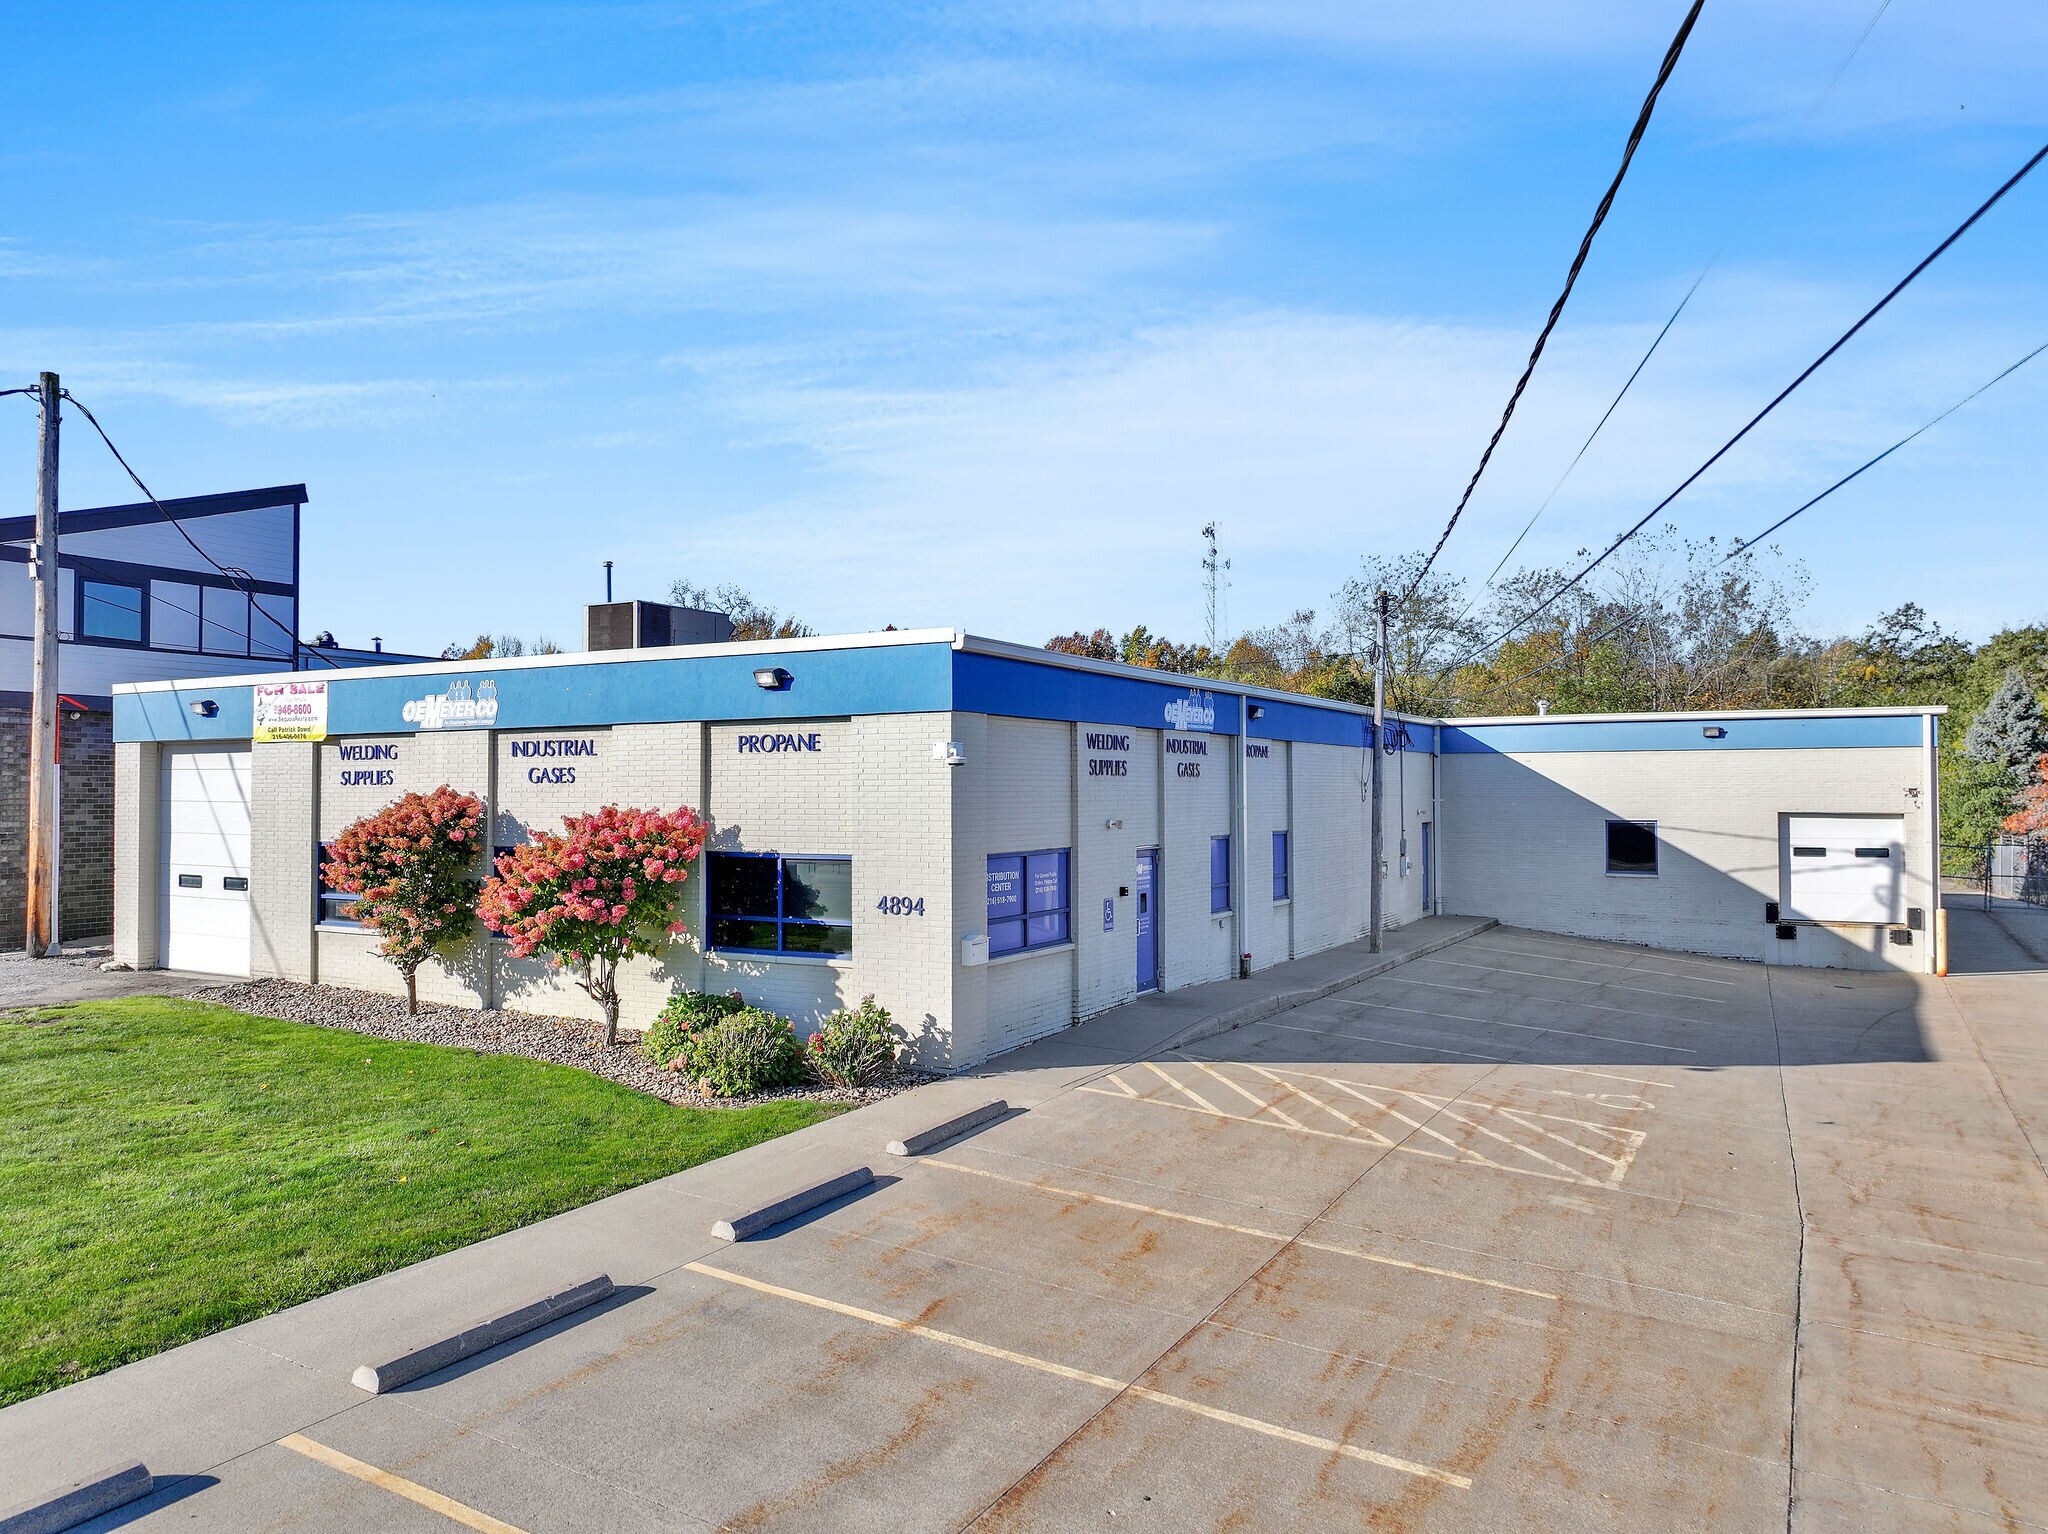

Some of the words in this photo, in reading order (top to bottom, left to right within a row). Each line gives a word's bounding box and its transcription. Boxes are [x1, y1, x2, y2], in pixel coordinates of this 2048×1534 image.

[257, 684, 284, 696] FOR
[290, 683, 325, 695] SALE
[511, 739, 598, 758] INDUSTRIAL
[738, 733, 822, 753] PROPANE
[1086, 732, 1130, 752] WELDING
[1166, 738, 1208, 756] INDUSTRIAL
[339, 744, 399, 761] WELDING
[1246, 744, 1271, 759] ROPANE
[528, 766, 576, 785] GASES
[1088, 759, 1127, 777] SUPPLIES
[1177, 762, 1201, 778] GASES
[340, 769, 394, 786] SUPPLIES
[990, 882, 1012, 893] CENTER
[876, 895, 926, 917] 4894
